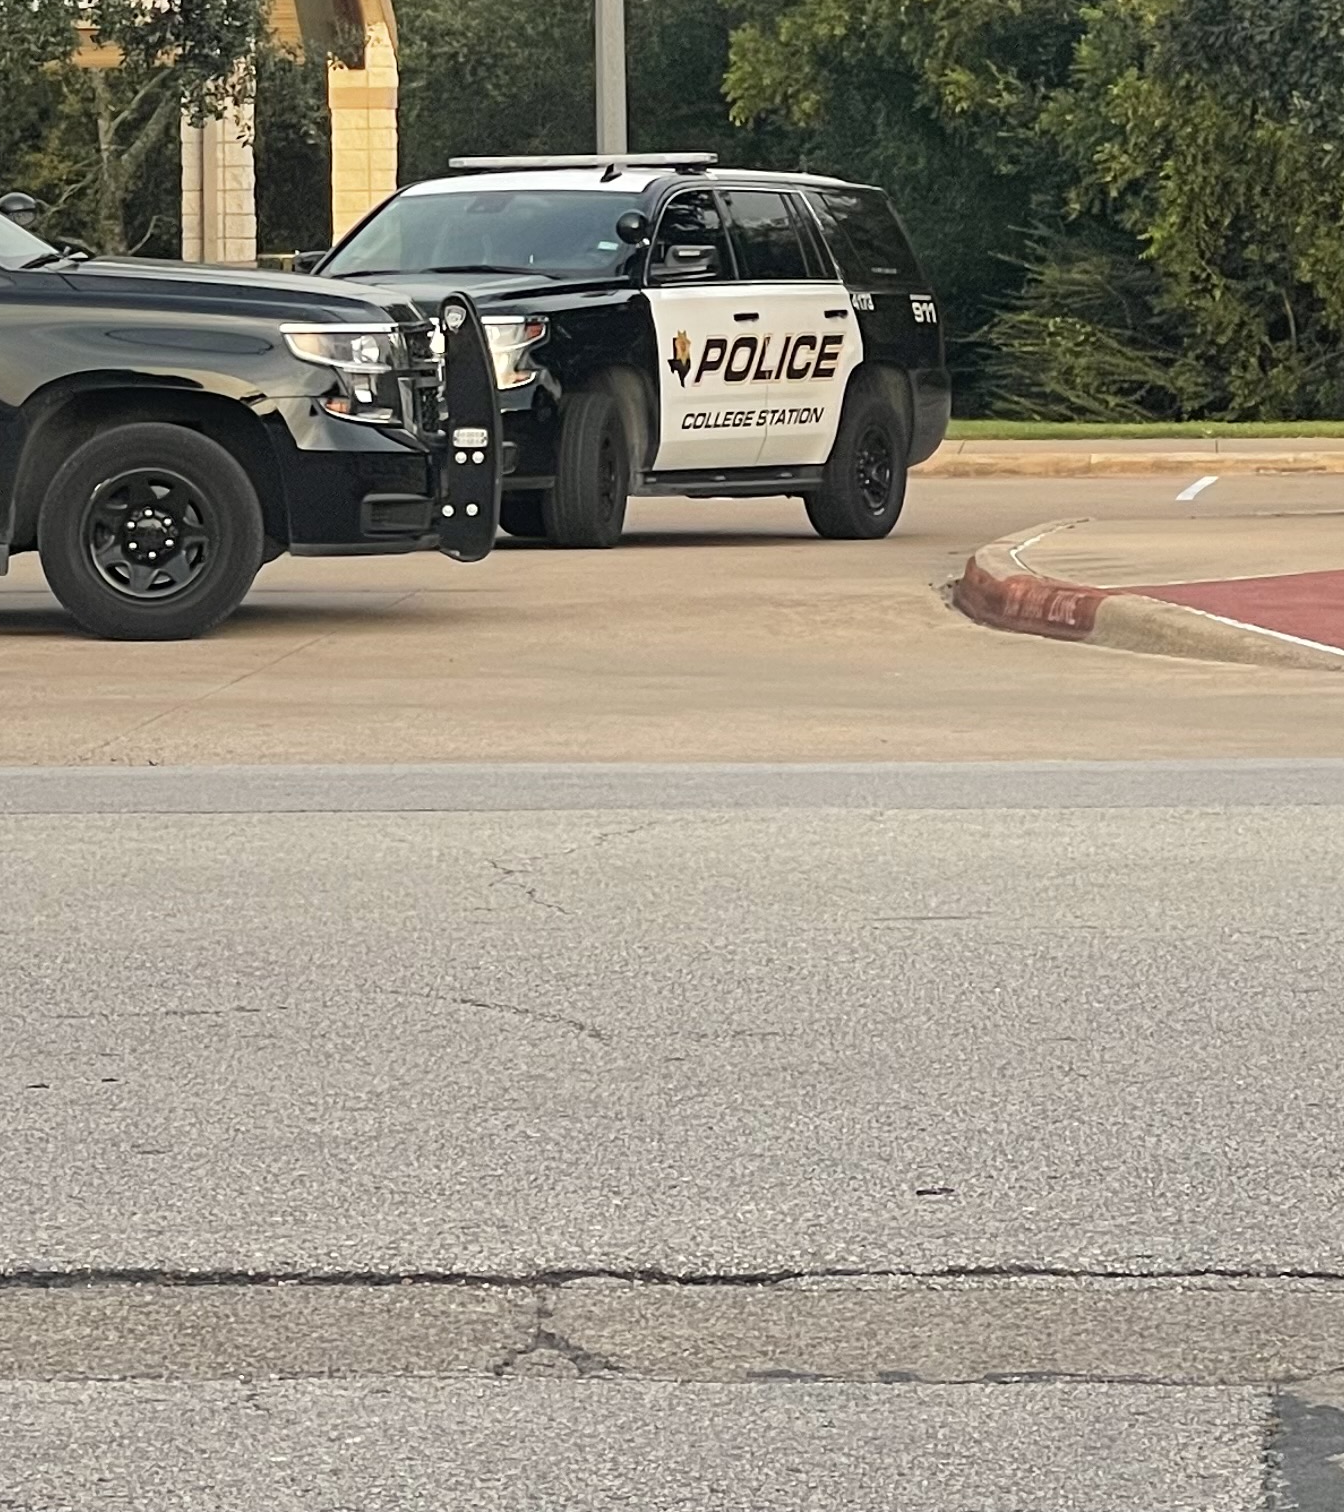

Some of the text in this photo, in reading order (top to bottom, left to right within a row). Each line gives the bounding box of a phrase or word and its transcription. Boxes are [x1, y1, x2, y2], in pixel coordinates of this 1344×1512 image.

[911, 302, 937, 323] 911
[692, 332, 846, 386] POLICE
[681, 407, 825, 430] COLLEGE STATION
